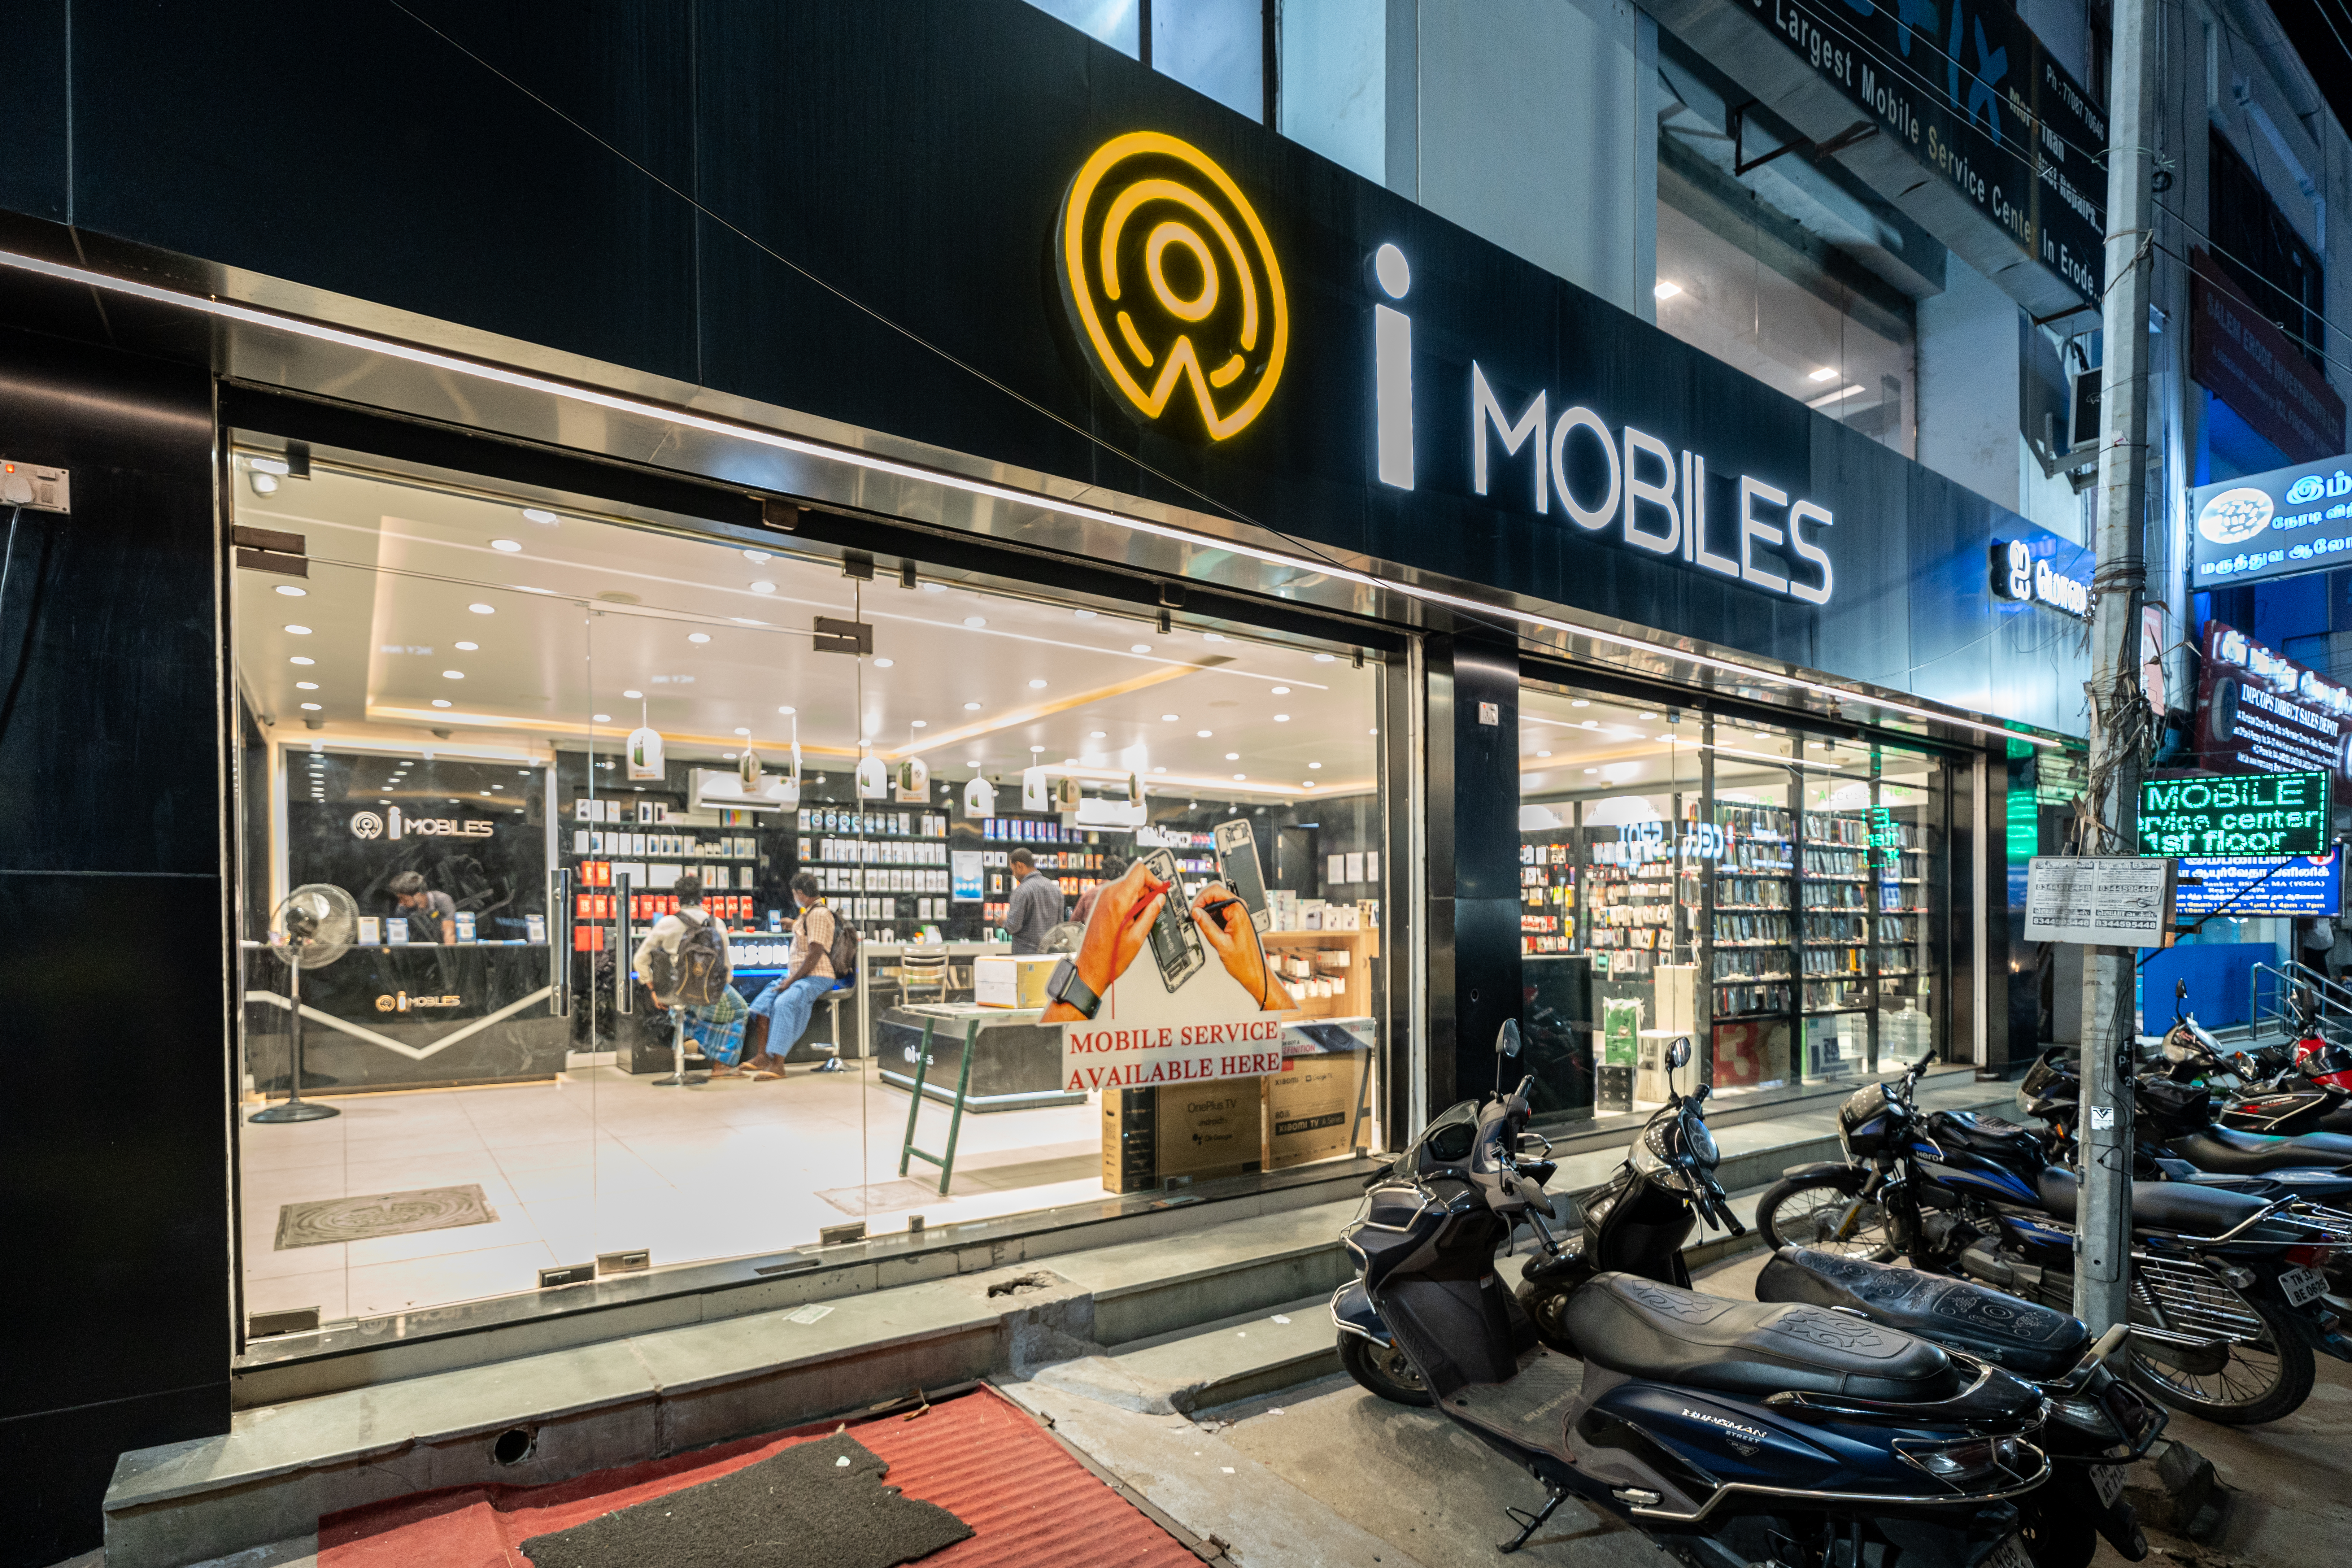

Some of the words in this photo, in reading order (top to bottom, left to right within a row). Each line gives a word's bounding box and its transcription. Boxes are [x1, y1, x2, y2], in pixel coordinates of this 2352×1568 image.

[1775, 0, 1851, 87] Largest
[1862, 64, 1918, 143] Mobile
[1928, 125, 1985, 203] Service
[1993, 185, 2032, 243] Cente
[2043, 228, 2055, 263] In
[1375, 243, 1414, 491] i
[1473, 360, 1833, 604] MOBILES
[2201, 549, 2285, 576] மருத்துவ
[2241, 683, 2275, 713] IMPCOPS
[2274, 696, 2300, 722] DIRECT
[2299, 708, 2319, 732] SALES
[2318, 715, 2339, 737] DEPOT
[1818, 786, 1912, 802] Accessries
[2147, 779, 2305, 810] MOBILE
[404, 817, 494, 837] MOBILES
[2221, 810, 2319, 829] center
[2144, 831, 2195, 852] 1st
[2202, 829, 2287, 852] floor
[2096, 920, 2156, 929] 8344595448
[406, 994, 461, 1007] MOBILES
[1069, 1027, 1173, 1054] MOBILE
[1181, 1021, 1278, 1046] SERVICE
[1067, 1058, 1214, 1090] AVAILABLE
[1220, 1052, 1280, 1075] HERE
[1188, 1100, 1224, 1113] OnePlus
[1225, 1098, 1237, 1109] TV
[1310, 1119, 1319, 1128] TV
[1916, 1150, 1939, 1161] Hero
[2290, 1273, 2303, 1286] TN
[2294, 1288, 2307, 1302] BE
[1682, 1408, 1767, 1438] BURGMAN
[1725, 1430, 1760, 1443] STREET
